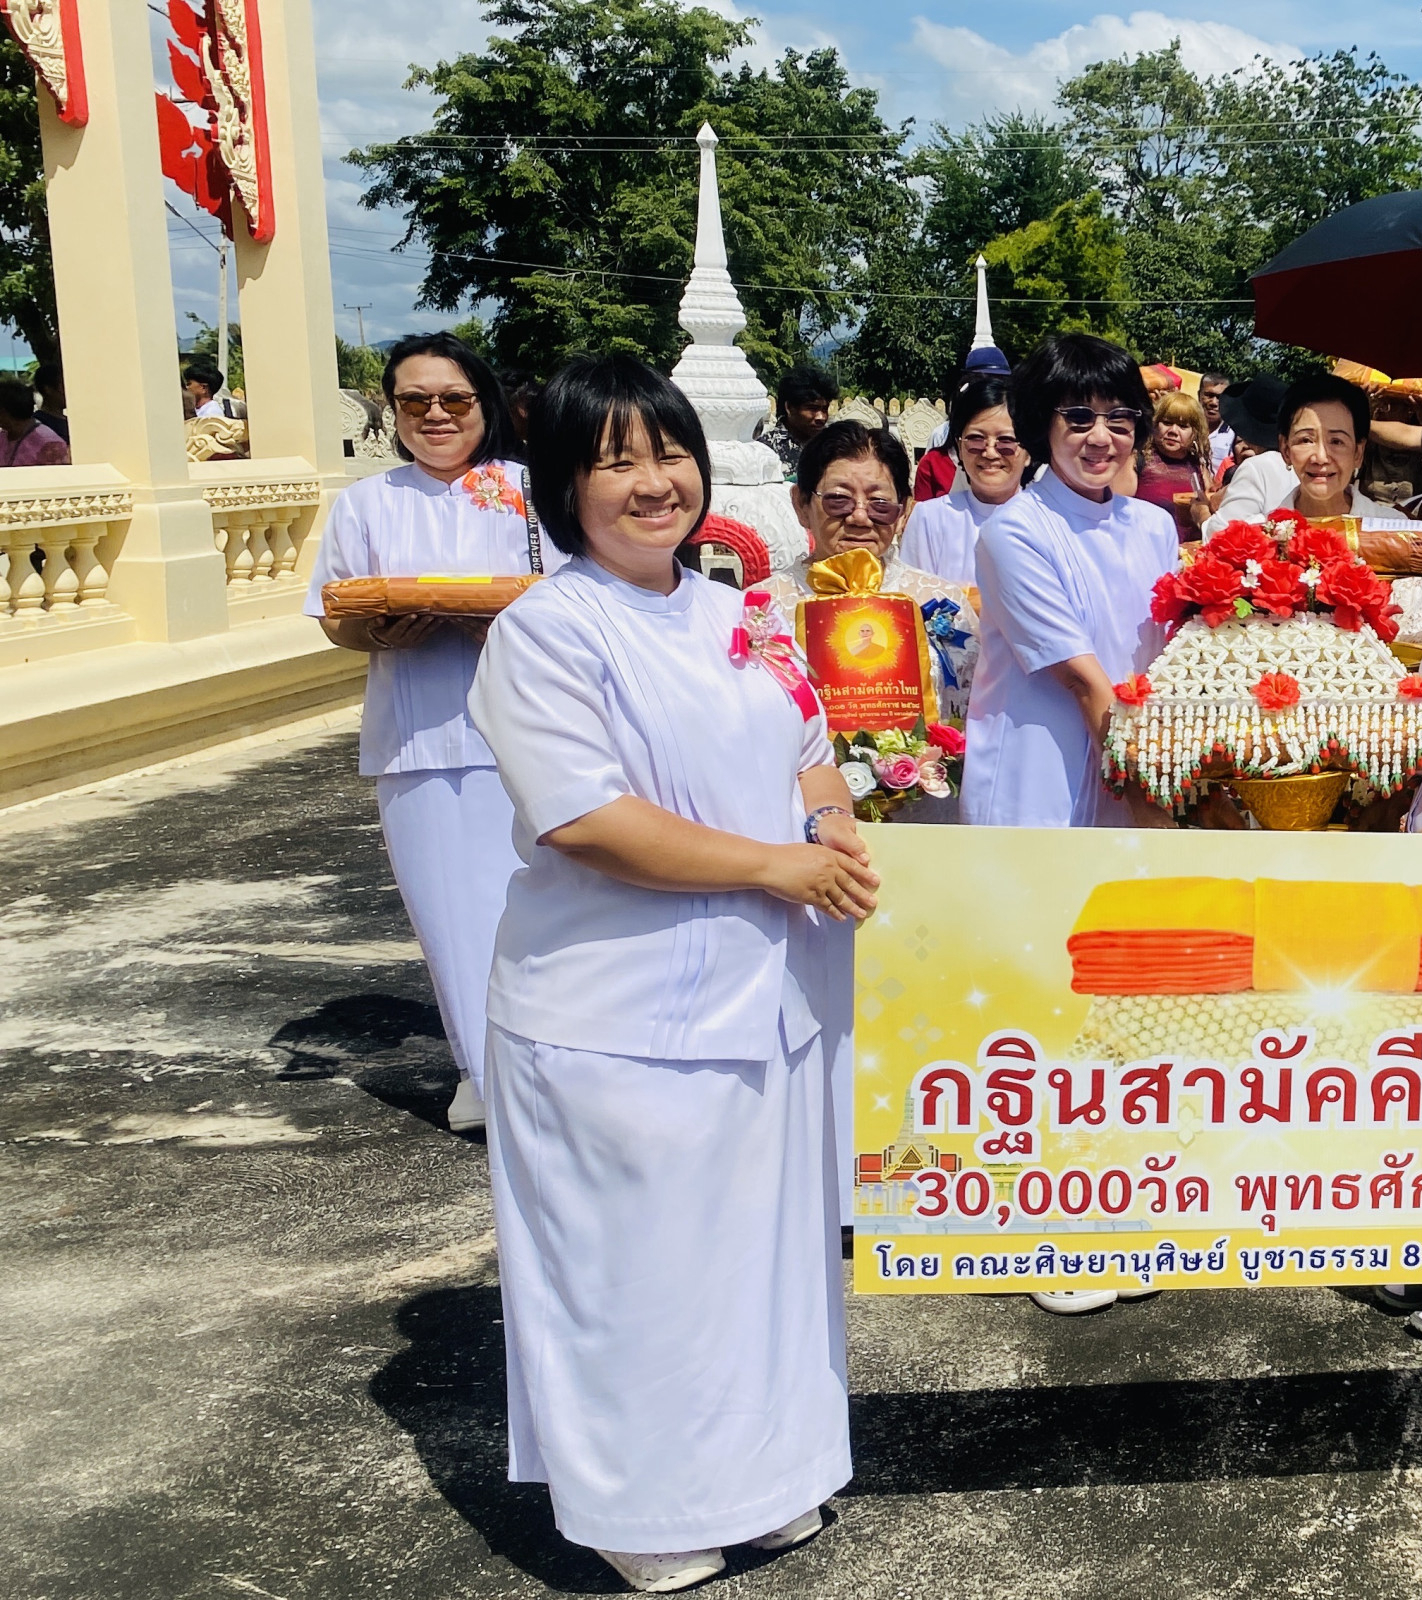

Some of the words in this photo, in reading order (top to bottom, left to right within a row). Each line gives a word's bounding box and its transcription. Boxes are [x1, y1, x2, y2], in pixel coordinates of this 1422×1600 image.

[530, 533, 543, 575] FOREVER
[916, 1156, 1210, 1227] 30,000วัด
[876, 1244, 939, 1278] โดย
[955, 1239, 1227, 1283] คณะศิษยานุศิษย์
[1240, 1248, 1388, 1281] บูชาธรรม
